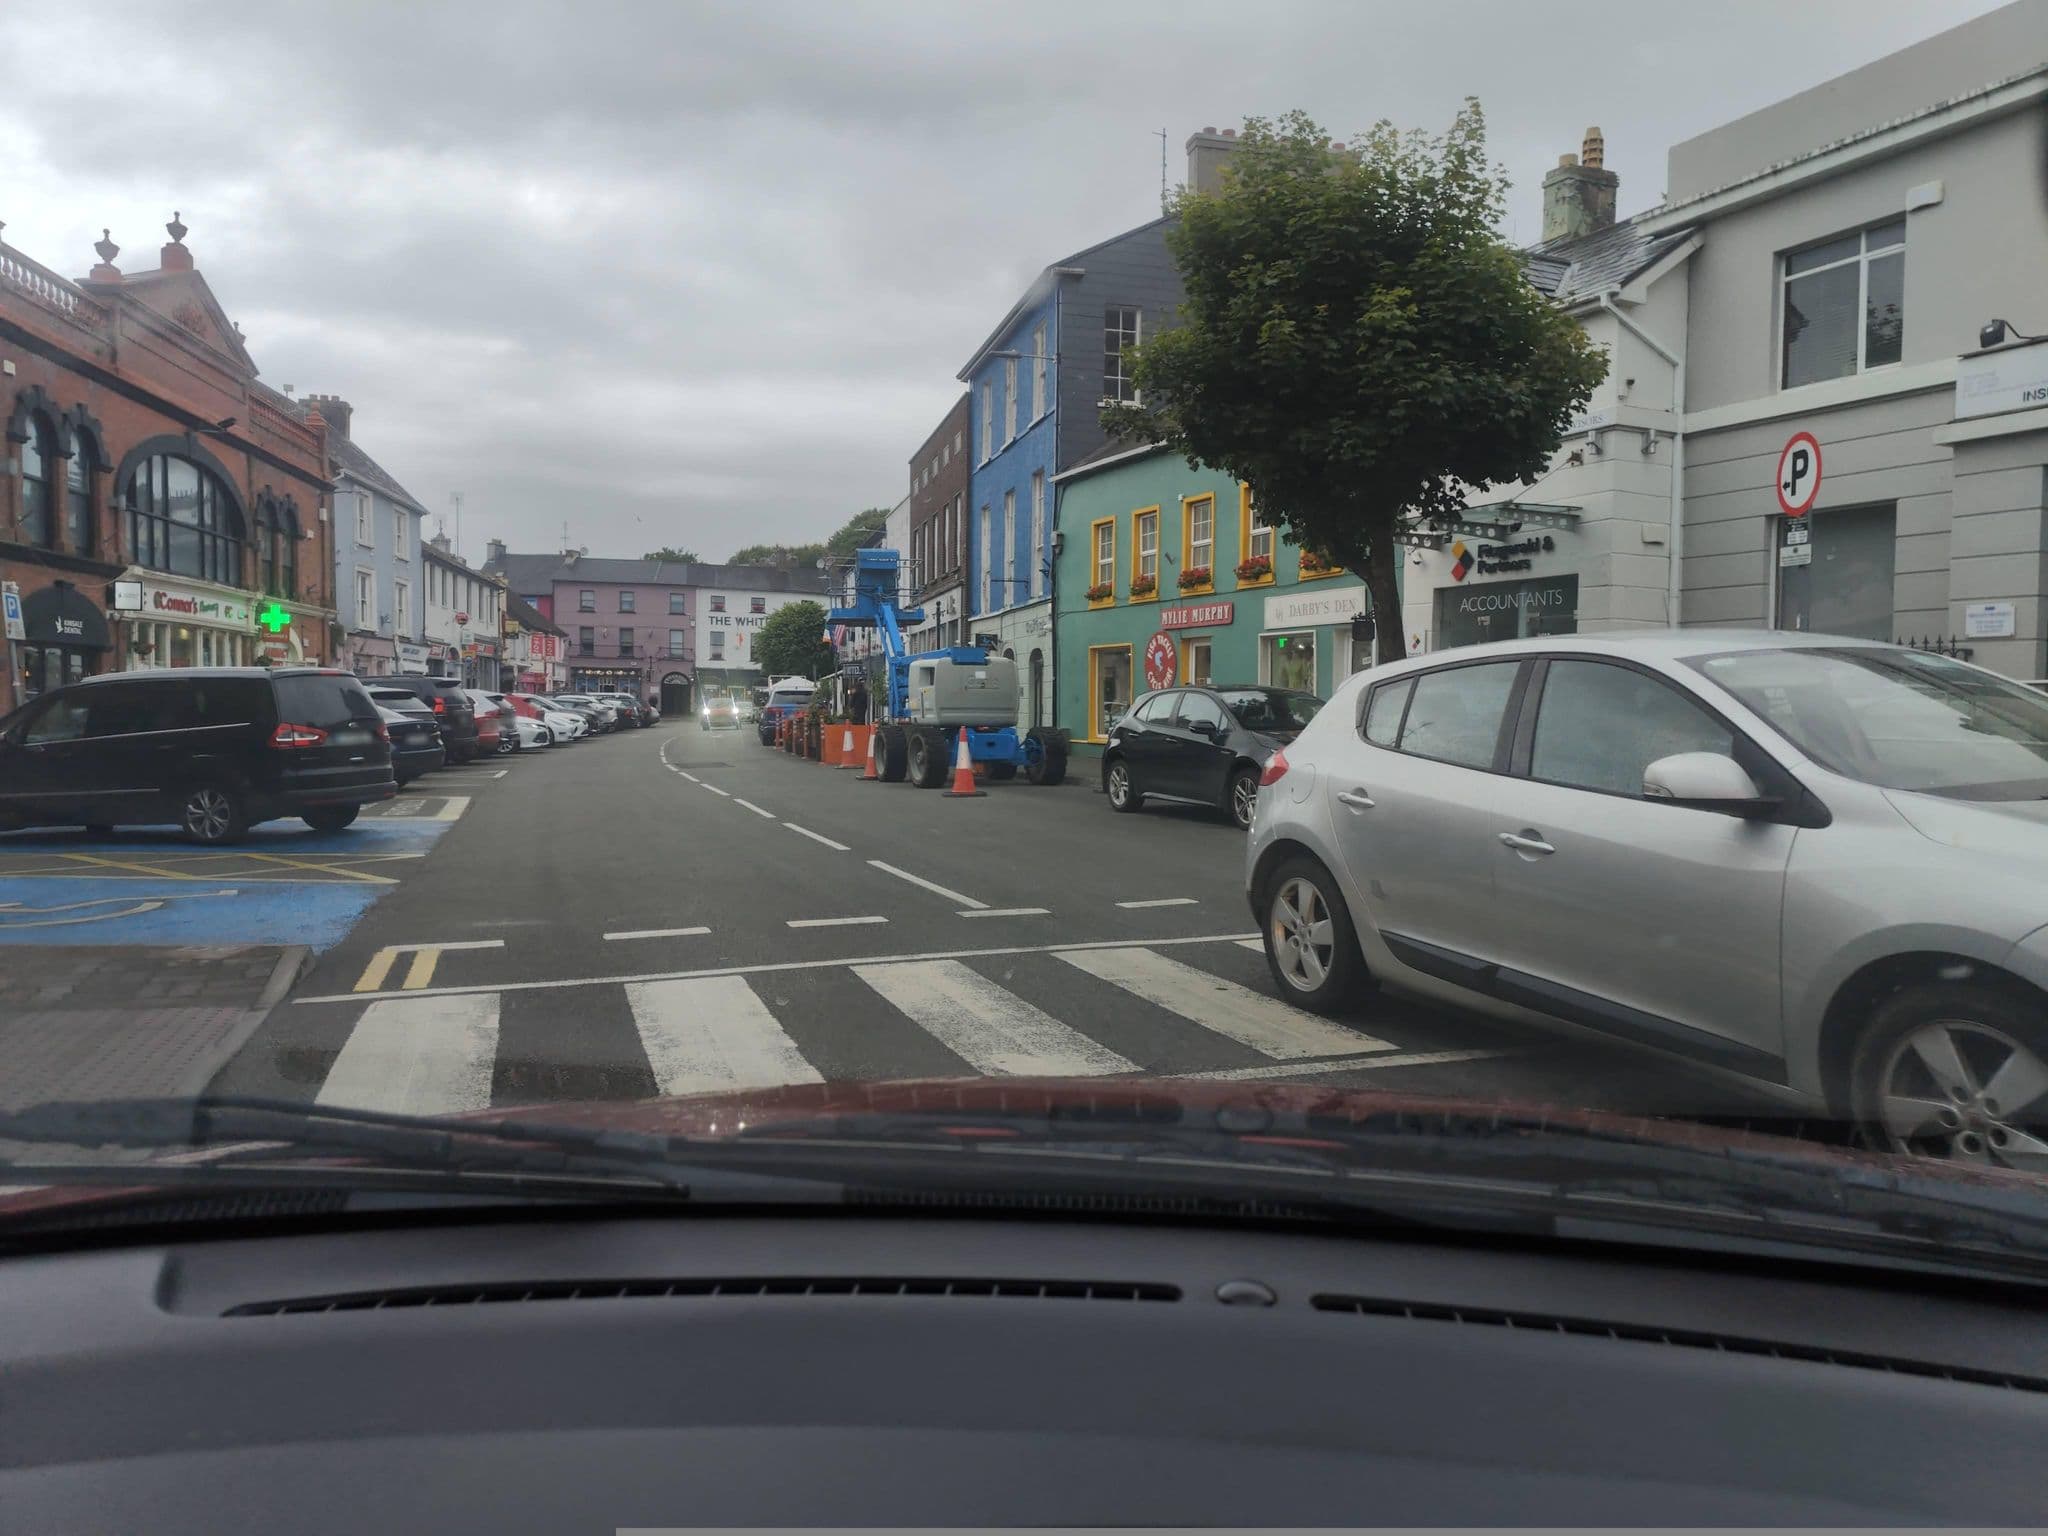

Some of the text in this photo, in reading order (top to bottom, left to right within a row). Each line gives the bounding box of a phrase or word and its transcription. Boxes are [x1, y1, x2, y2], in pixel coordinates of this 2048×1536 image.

[2023, 387, 2048, 402] INS
[1791, 449, 1808, 496] P
[1542, 536, 1555, 551] &
[7, 598, 17, 617] P
[1288, 598, 1357, 617] DARBY'S DEN
[1460, 589, 1563, 612] ACCOUNTANTS
[63, 619, 83, 629] KINSALE
[708, 616, 731, 626] THE
[1161, 604, 1230, 625] MYLIE MURPHY
